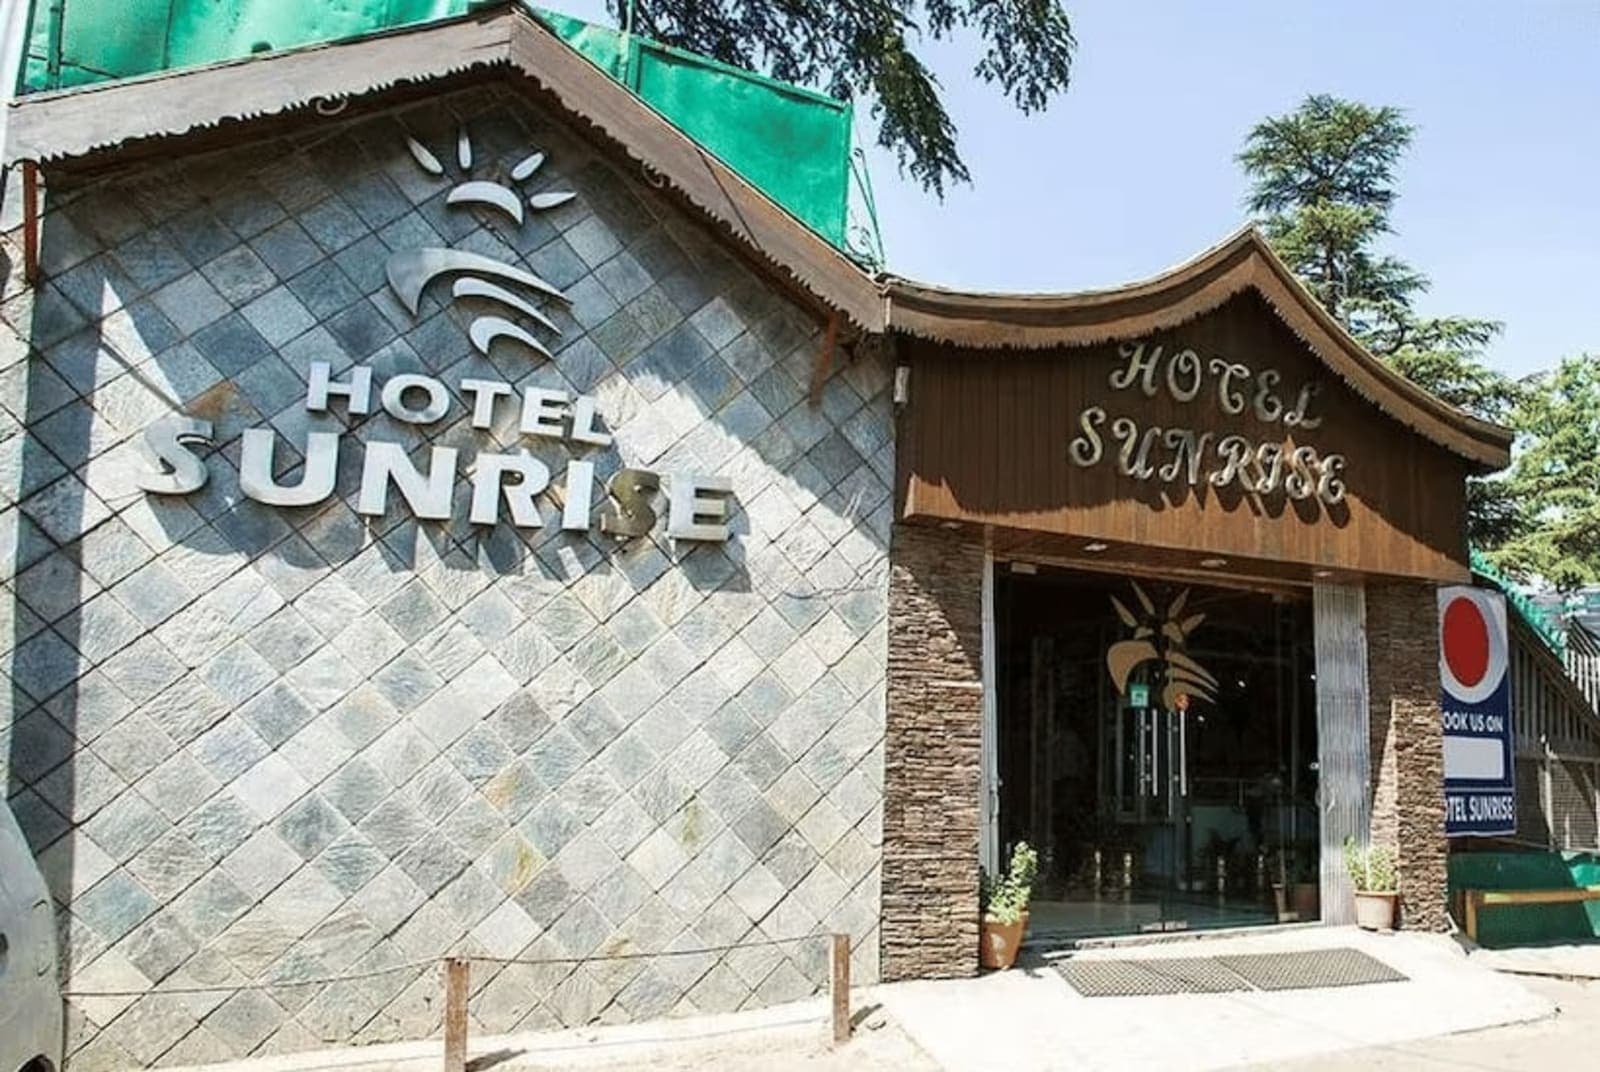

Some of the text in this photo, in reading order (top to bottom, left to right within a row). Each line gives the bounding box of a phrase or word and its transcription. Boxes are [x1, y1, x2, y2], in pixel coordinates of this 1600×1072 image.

[306, 361, 613, 446] HOTEL
[1108, 341, 1322, 429] HOTEL
[137, 418, 734, 542] SUNRISE
[1068, 405, 1346, 502] SUNRISE
[1443, 711, 1504, 733] OOK US ON
[1444, 795, 1513, 822] TEL SUNRISE
